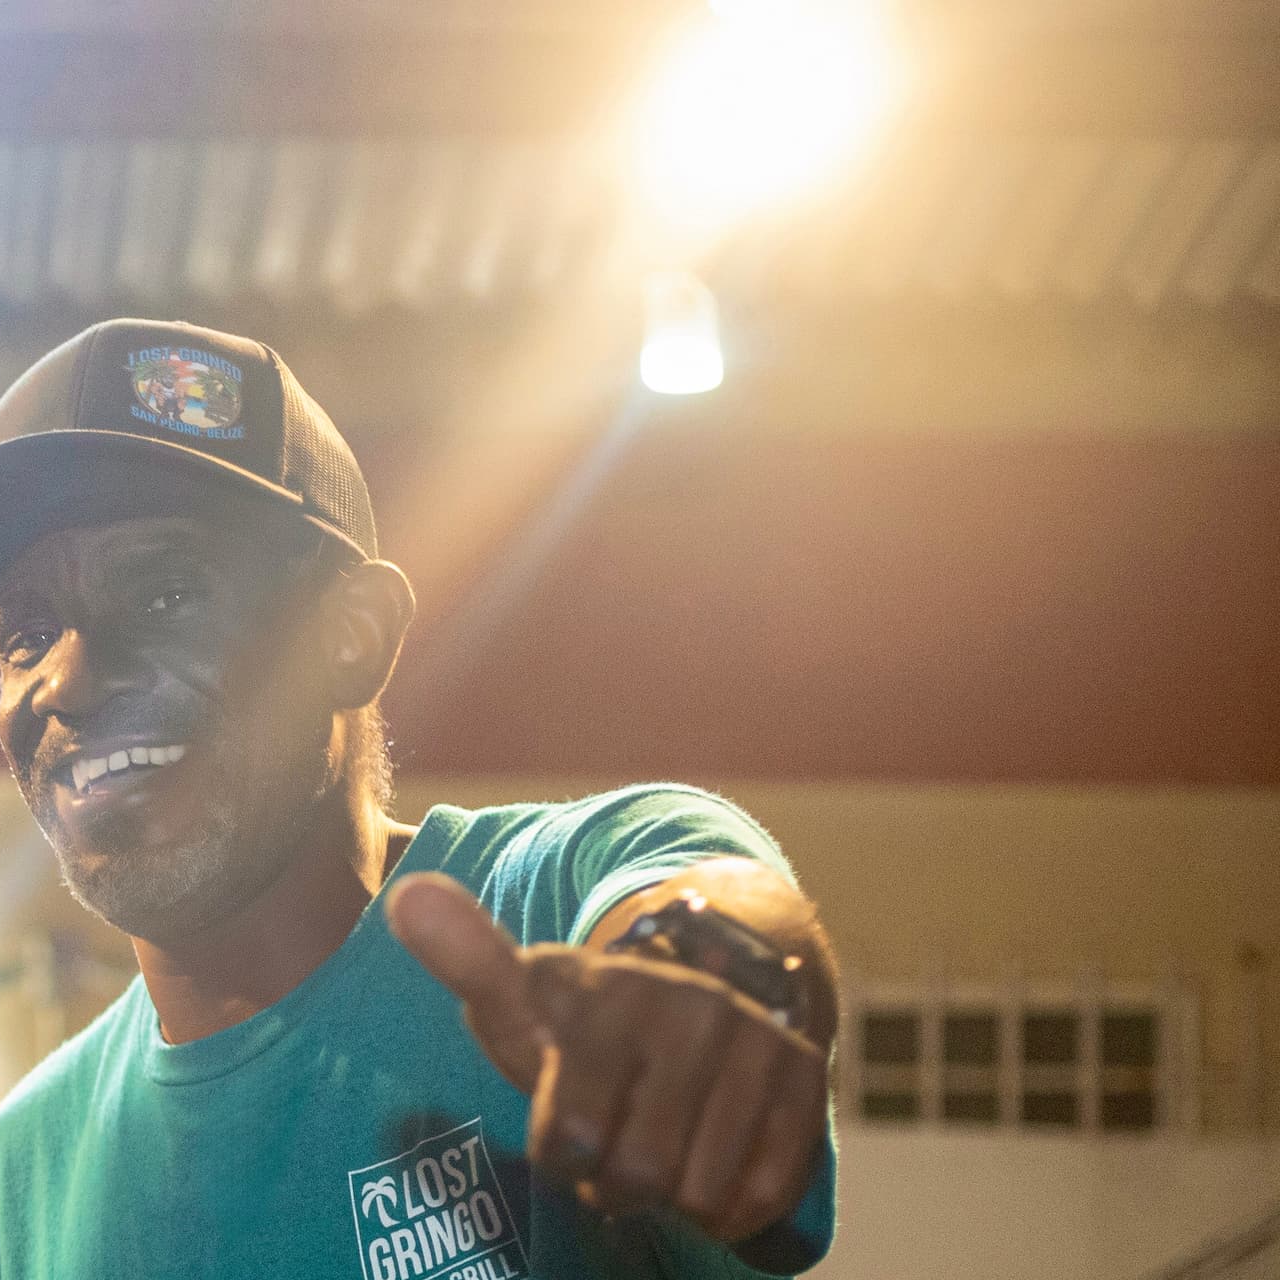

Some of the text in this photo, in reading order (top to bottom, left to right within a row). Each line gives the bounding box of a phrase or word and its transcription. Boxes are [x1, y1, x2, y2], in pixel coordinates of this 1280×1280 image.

[128, 346, 242, 383] LOST GRINGO
[130, 405, 157, 424] SAN
[207, 425, 245, 439] BELIZE
[403, 1135, 480, 1219] LOST
